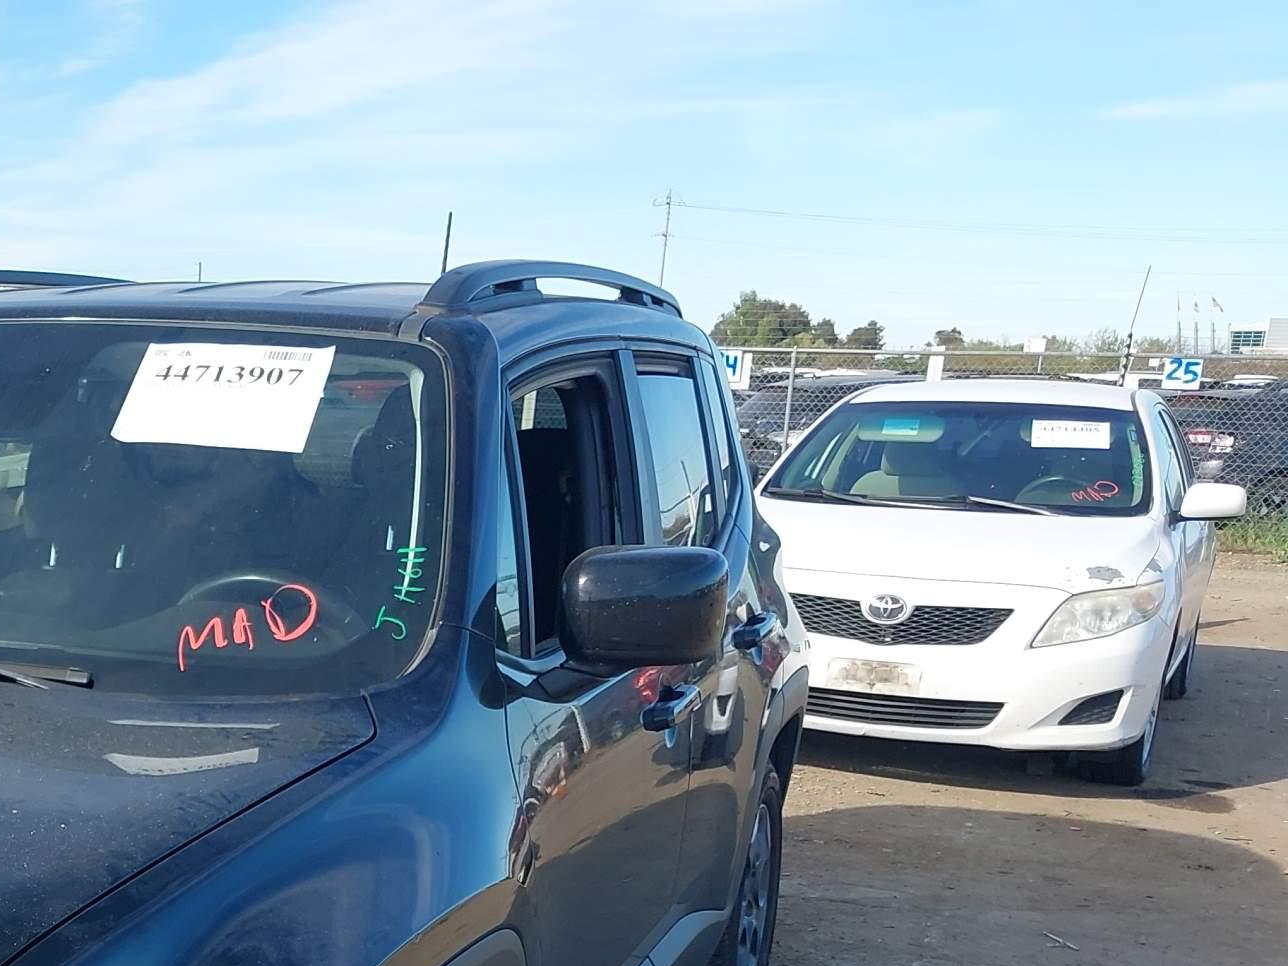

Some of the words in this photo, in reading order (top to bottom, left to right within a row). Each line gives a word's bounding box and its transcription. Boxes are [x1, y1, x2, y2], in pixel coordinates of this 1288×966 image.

[154, 364, 304, 387] 44713907
[721, 352, 738, 376] 4
[1165, 358, 1201, 384] 25
[177, 583, 317, 673] MAD
